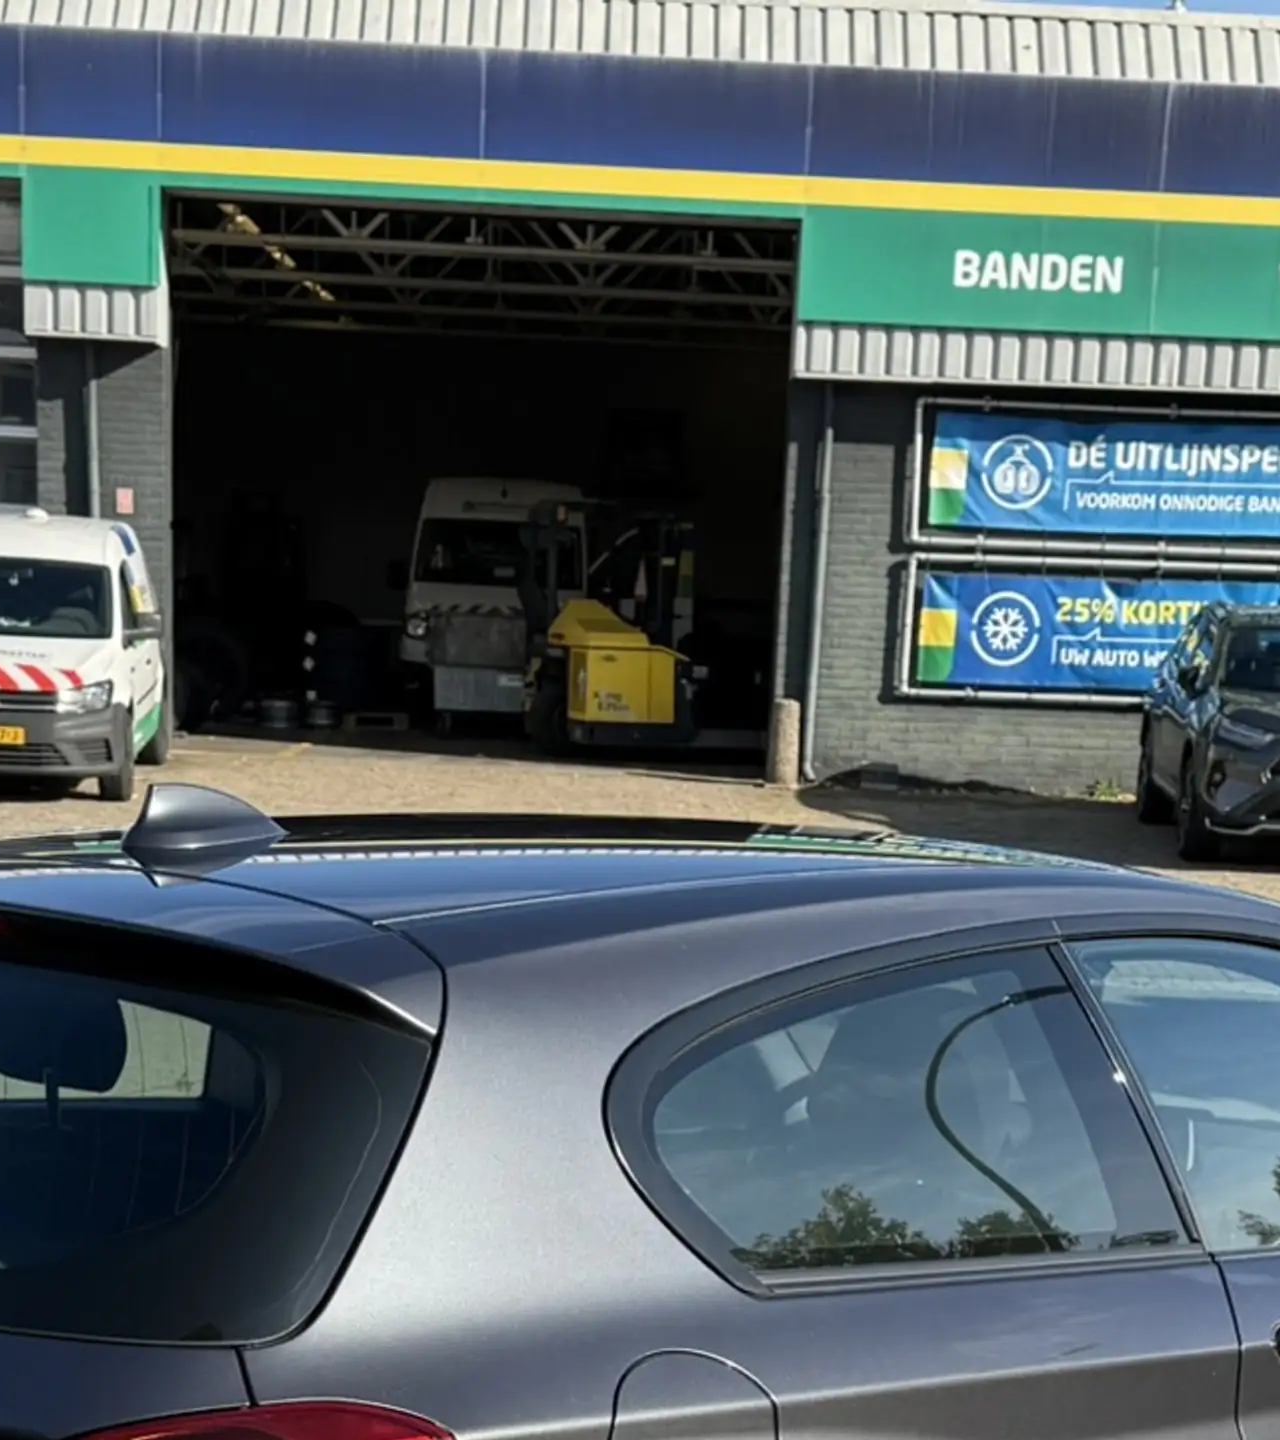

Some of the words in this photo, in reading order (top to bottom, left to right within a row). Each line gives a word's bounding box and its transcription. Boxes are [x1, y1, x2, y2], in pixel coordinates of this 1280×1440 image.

[952, 249, 1124, 294] BANDEN
[1068, 435, 1106, 469] DÉ
[1076, 491, 1156, 511] VOORKOM
[1159, 493, 1245, 514] ONNODIGE
[1055, 597, 1116, 625] 25%
[1121, 599, 1211, 626] KORTI
[1060, 645, 1091, 664] UW
[1092, 645, 1139, 667] AUTO
